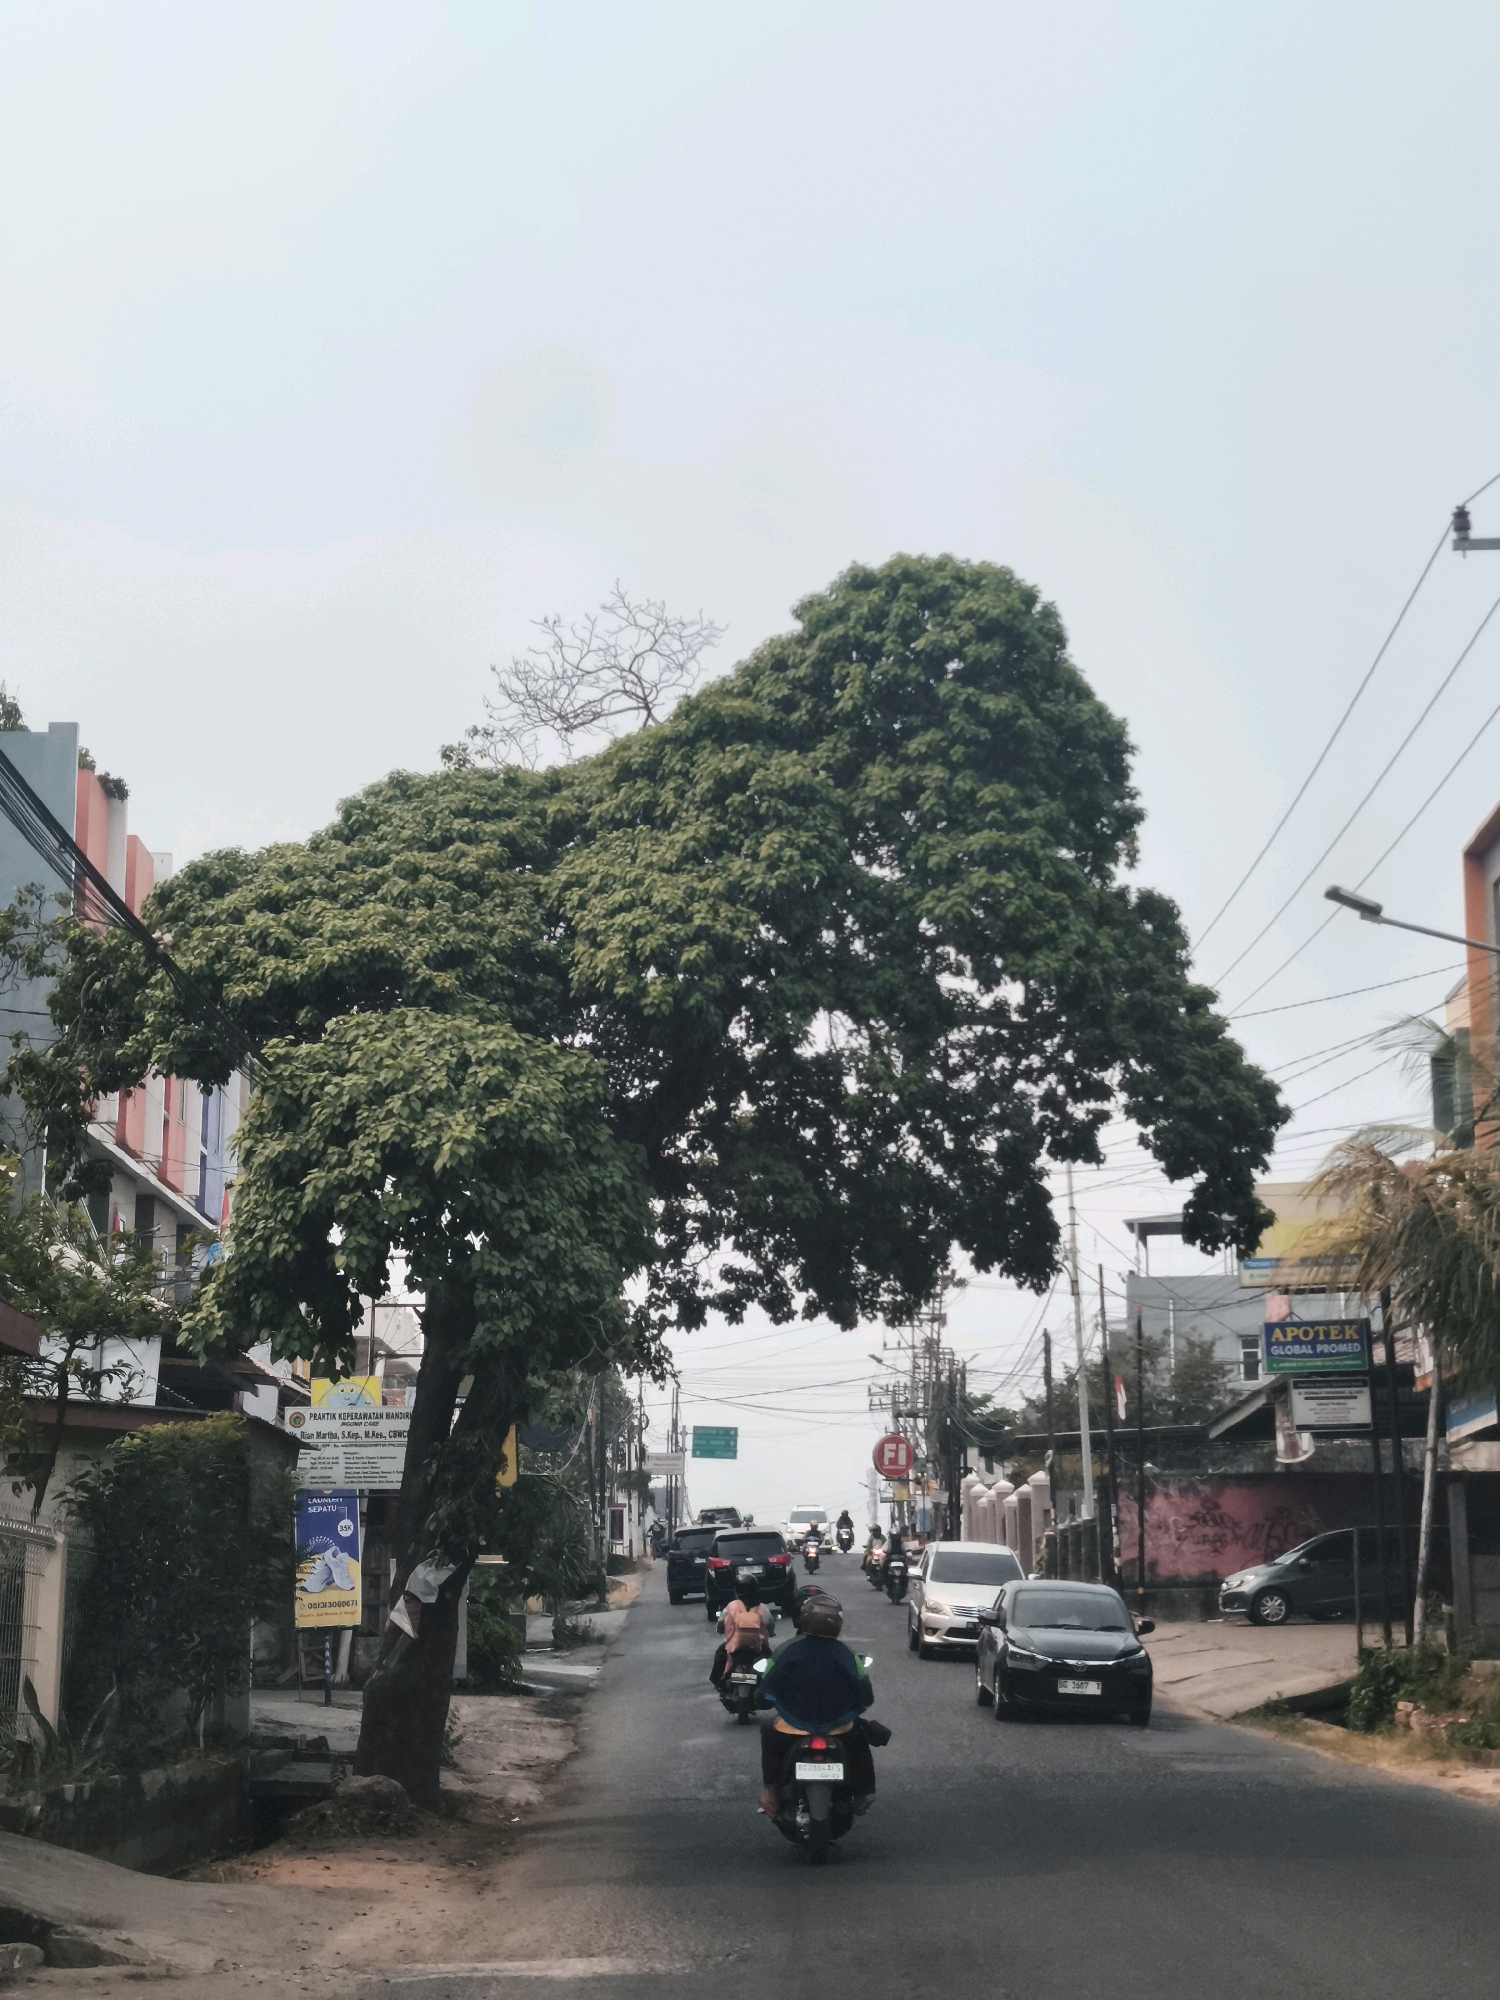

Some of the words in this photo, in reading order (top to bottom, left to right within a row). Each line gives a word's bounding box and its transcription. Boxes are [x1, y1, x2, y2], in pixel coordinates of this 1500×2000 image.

[1270, 1324, 1359, 1342] APOTEK
[1270, 1344, 1314, 1355] GLOBAL
[1316, 1342, 1361, 1353] PROMED
[309, 1412, 336, 1420] PRAKTIK
[338, 1411, 383, 1420] KEPERAWATAN
[300, 1430, 315, 1440] Rian
[308, 1504, 337, 1513] SEPATU
[339, 1524, 352, 1532] 35K
